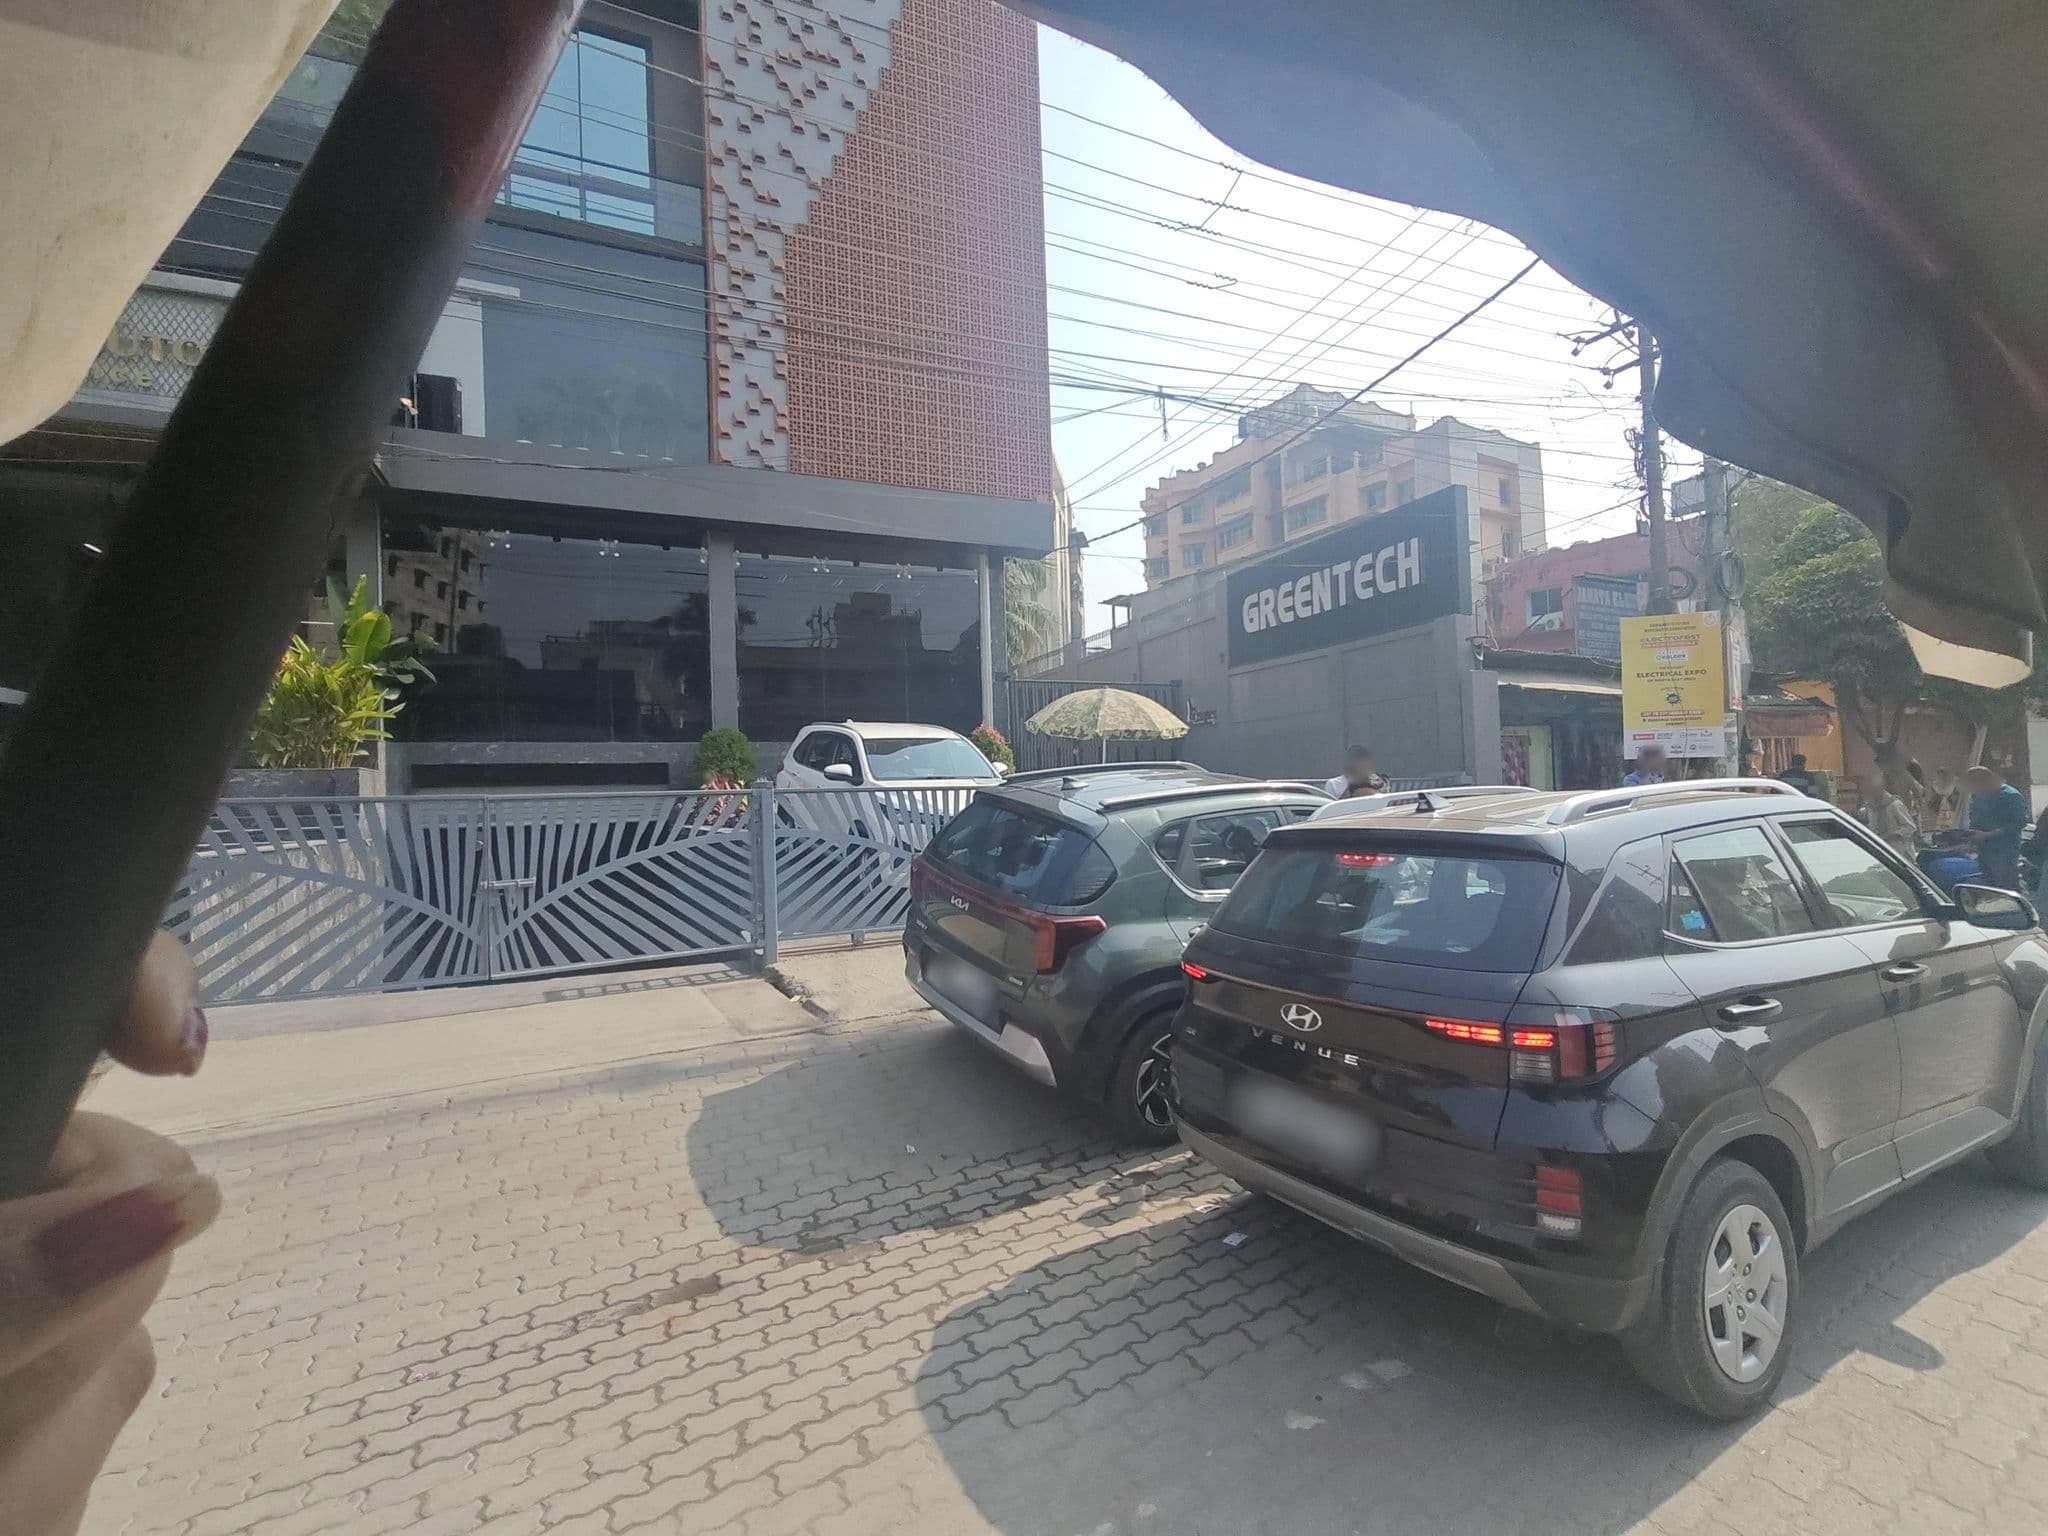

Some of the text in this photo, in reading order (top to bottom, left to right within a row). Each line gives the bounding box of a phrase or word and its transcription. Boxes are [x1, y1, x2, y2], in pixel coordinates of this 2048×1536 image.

[1242, 537, 1420, 633] GREENTECH
[1636, 671, 1682, 679] ELECTRICAL
[951, 896, 969, 911] KIA
[1252, 1026, 1359, 1066] VENUE
